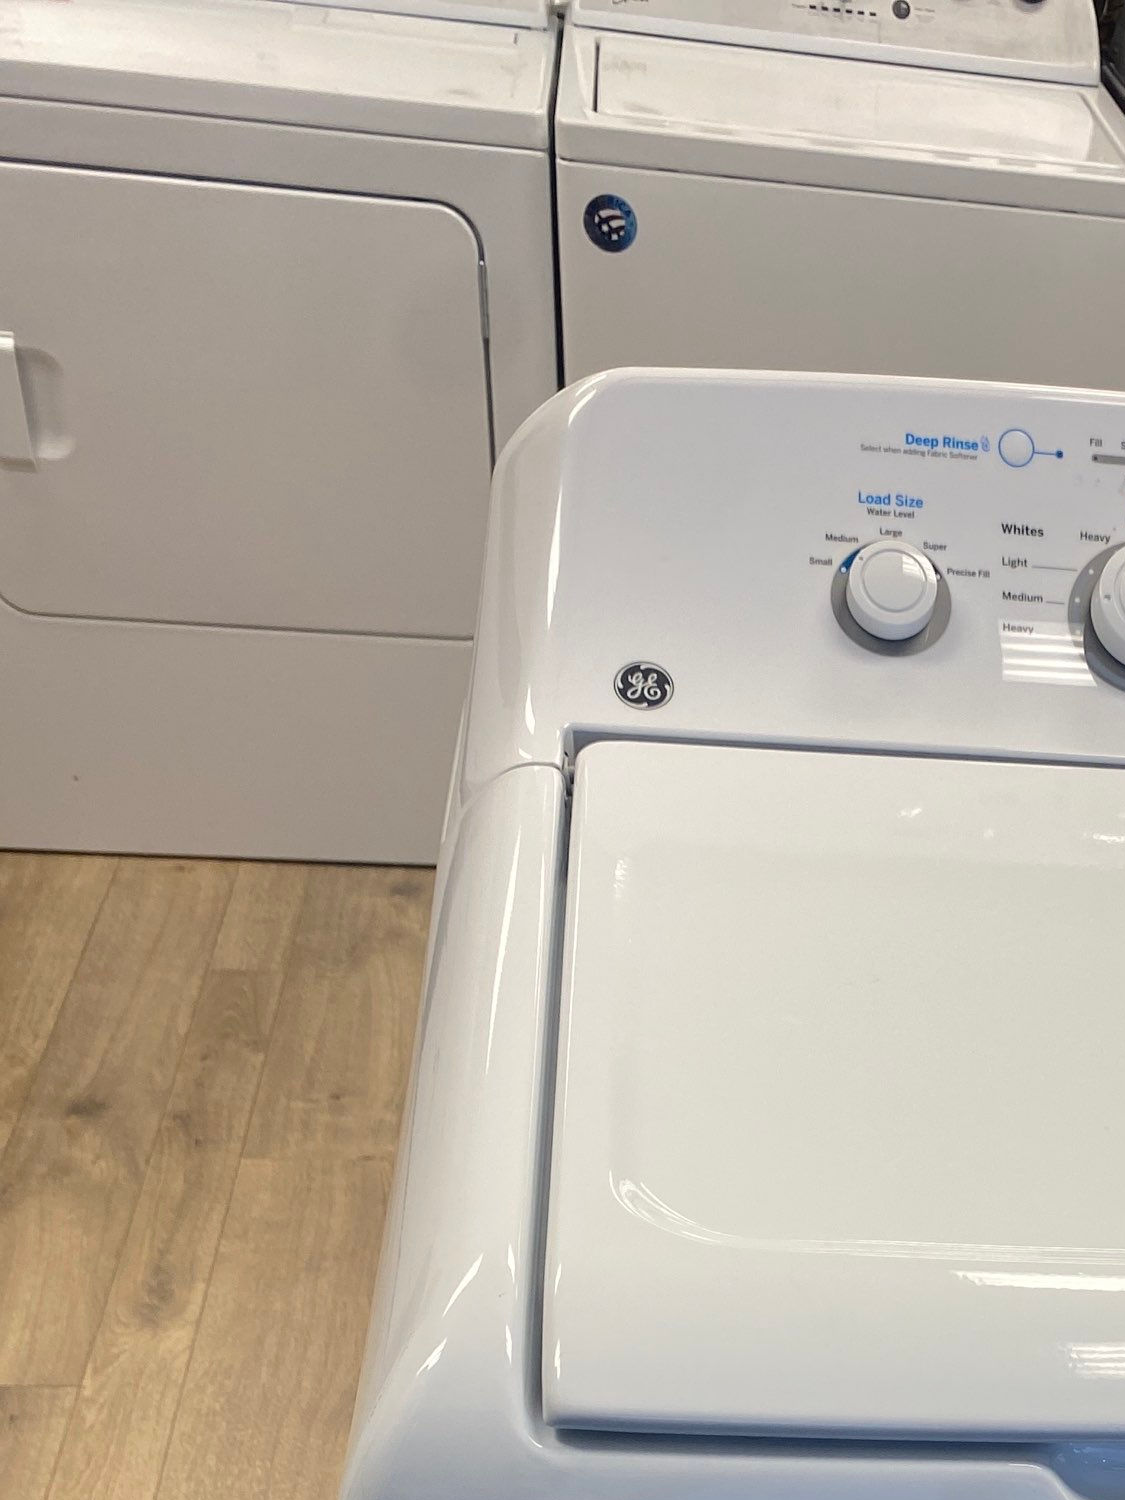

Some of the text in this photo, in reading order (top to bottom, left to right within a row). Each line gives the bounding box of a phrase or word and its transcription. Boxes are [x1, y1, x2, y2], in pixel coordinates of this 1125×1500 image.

[905, 433, 978, 451] Deep Rinse
[1089, 438, 1103, 448] Fill
[858, 490, 924, 509] Load Size
[867, 508, 915, 519] Water Level
[879, 527, 903, 538] Large
[1001, 523, 1044, 537] Whites
[825, 533, 859, 544] Medium
[1080, 531, 1111, 545] Heavy
[922, 541, 948, 552] Super
[809, 556, 833, 566] Small
[1002, 556, 1028, 569] Light
[946, 568, 991, 578] Precise Fill
[1002, 591, 1043, 604] Medium
[1002, 623, 1034, 636] Heavy
